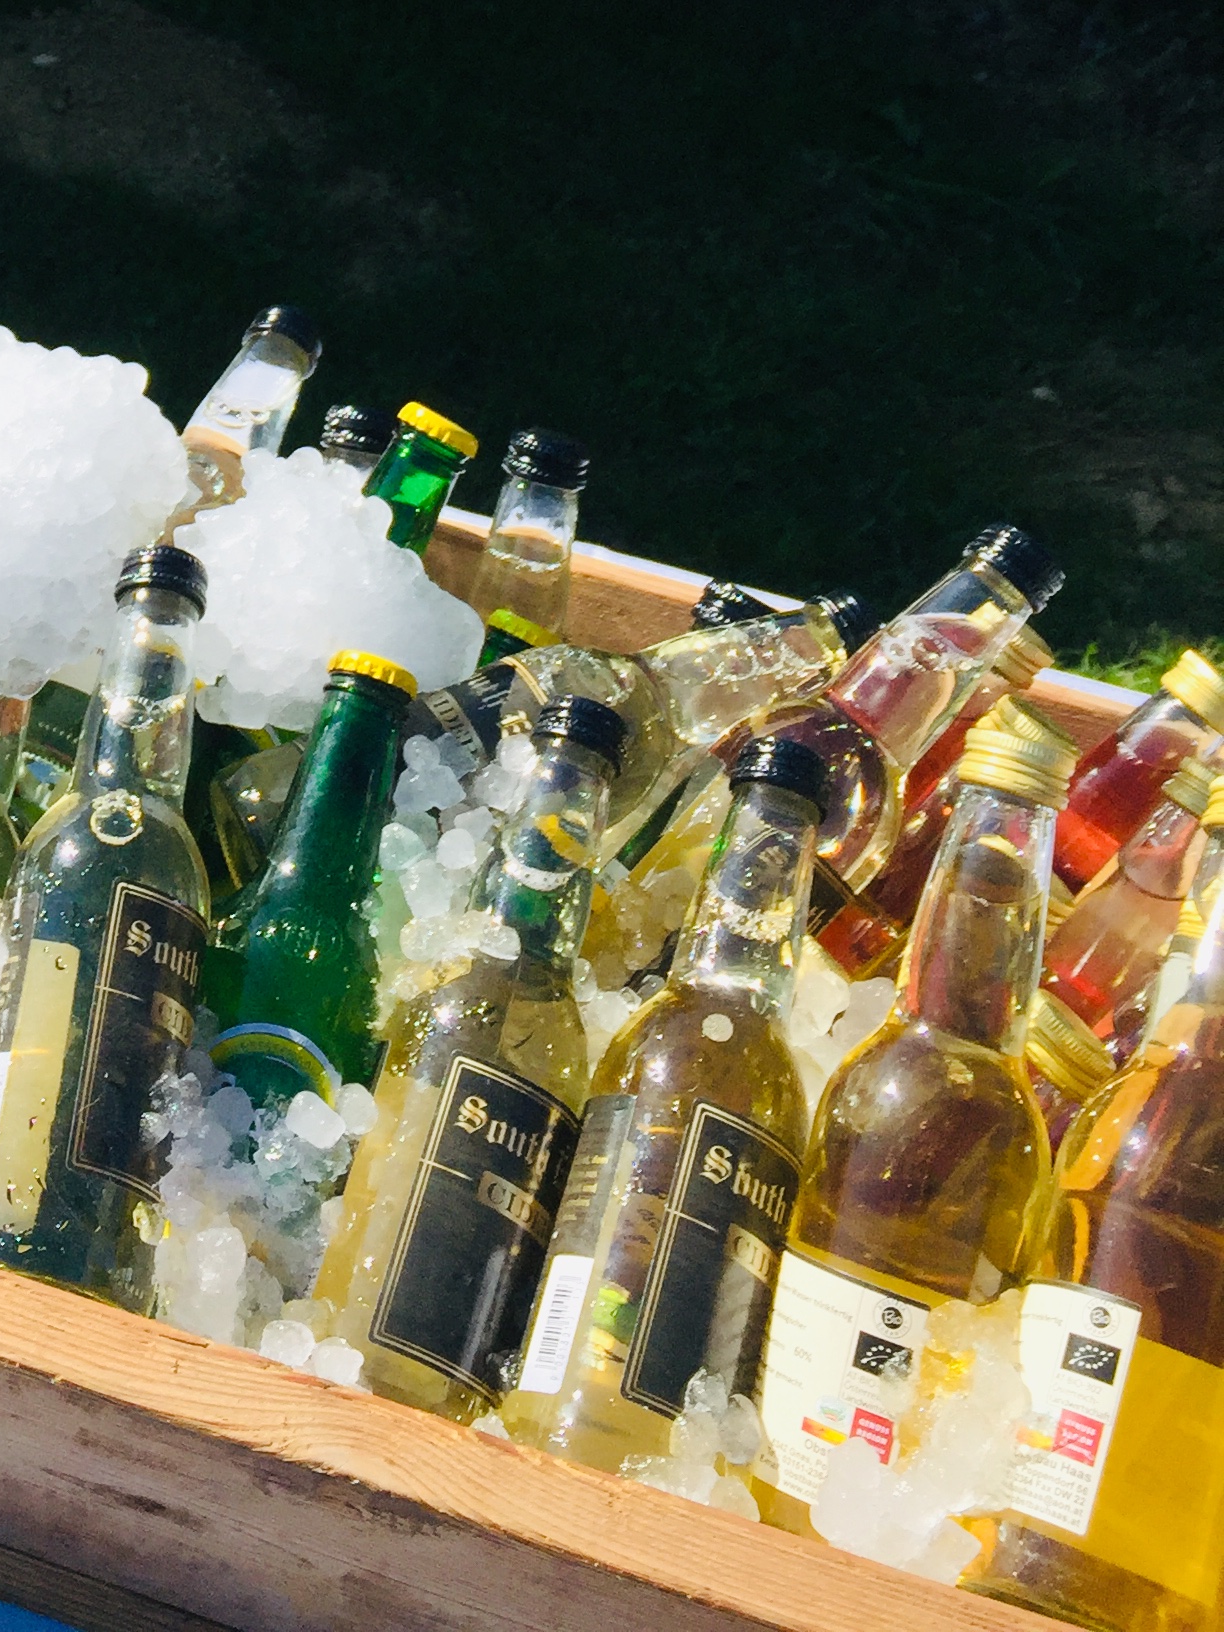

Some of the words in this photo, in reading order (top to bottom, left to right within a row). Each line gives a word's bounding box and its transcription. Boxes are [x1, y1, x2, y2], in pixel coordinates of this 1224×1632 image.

[124, 920, 200, 987] South
[454, 1095, 553, 1190] South
[699, 1145, 786, 1225] South
[858, 1417, 891, 1436] GENUSS
[1059, 1462, 1093, 1483] Haas
[1053, 1486, 1072, 1500] DW
[1072, 1494, 1085, 1506] 22
